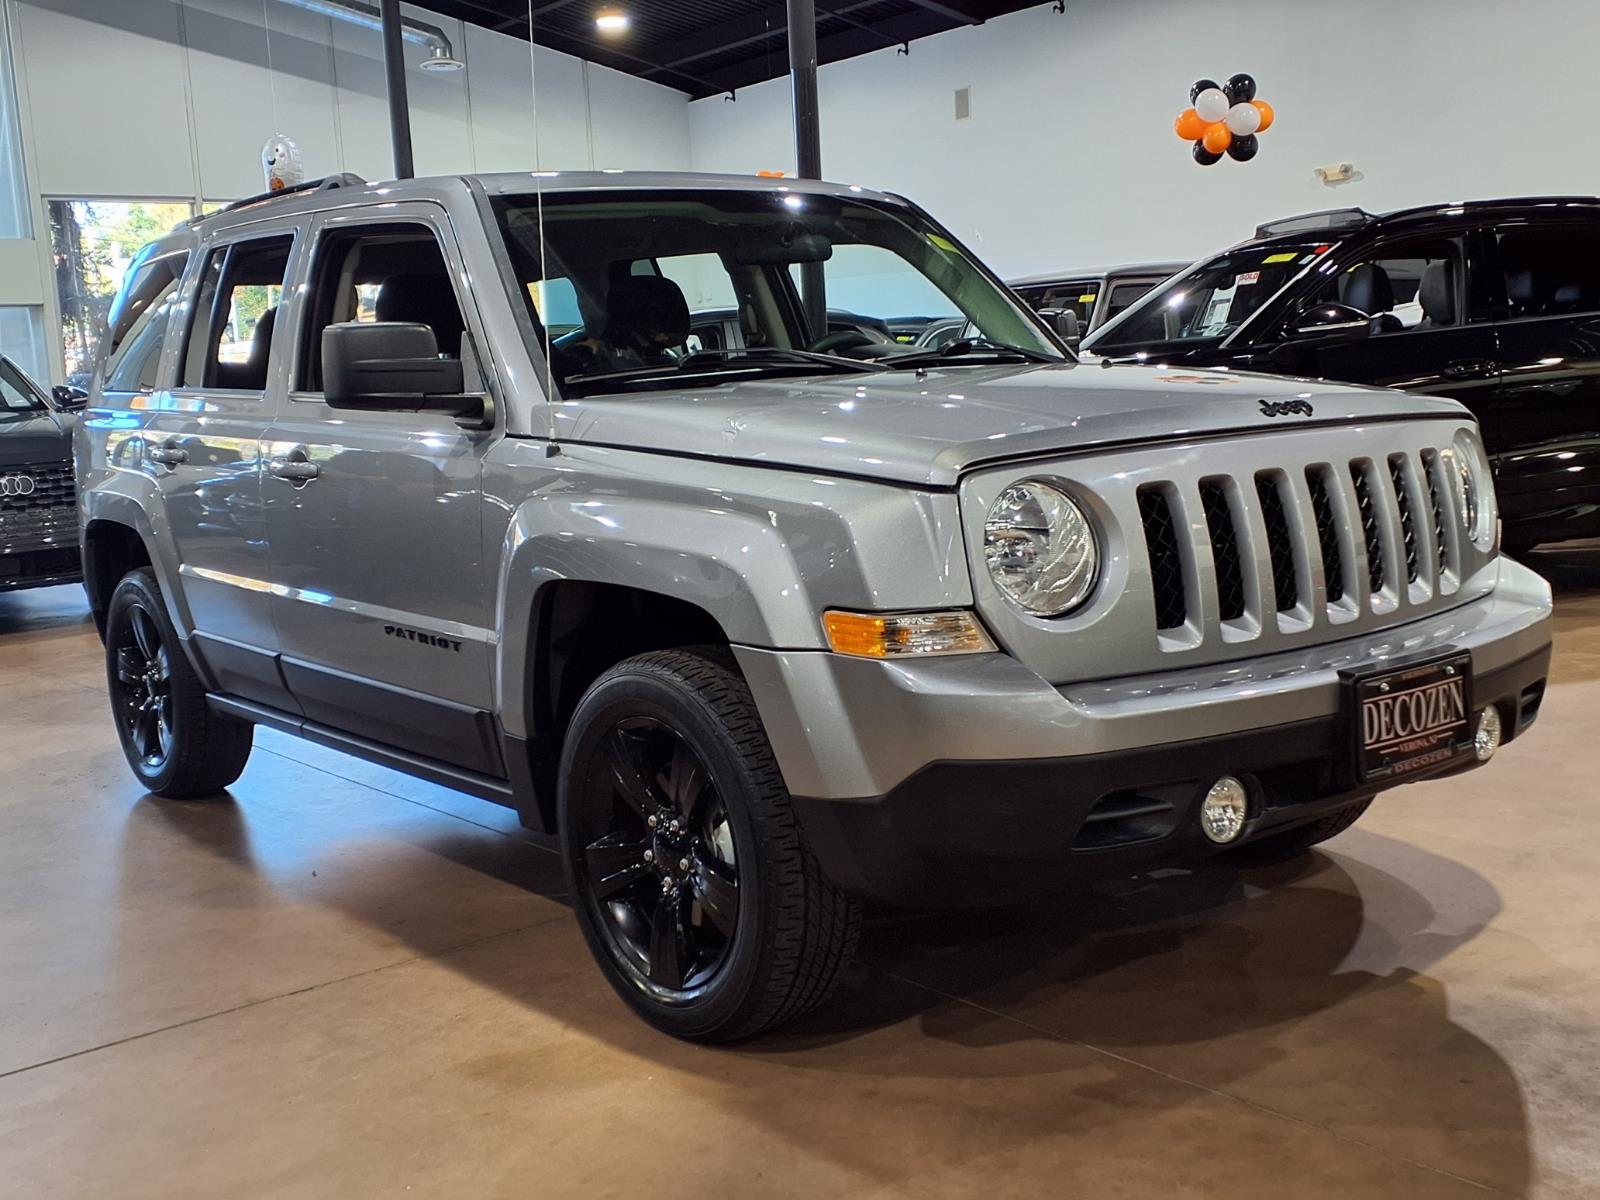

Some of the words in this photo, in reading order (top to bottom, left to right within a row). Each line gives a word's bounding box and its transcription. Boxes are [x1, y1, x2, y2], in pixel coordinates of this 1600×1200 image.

[1259, 399, 1313, 417] Jeep
[383, 625, 462, 652] PATRIOT
[1363, 681, 1464, 744] DECOZEN
[1394, 750, 1451, 772] DECOZEN
